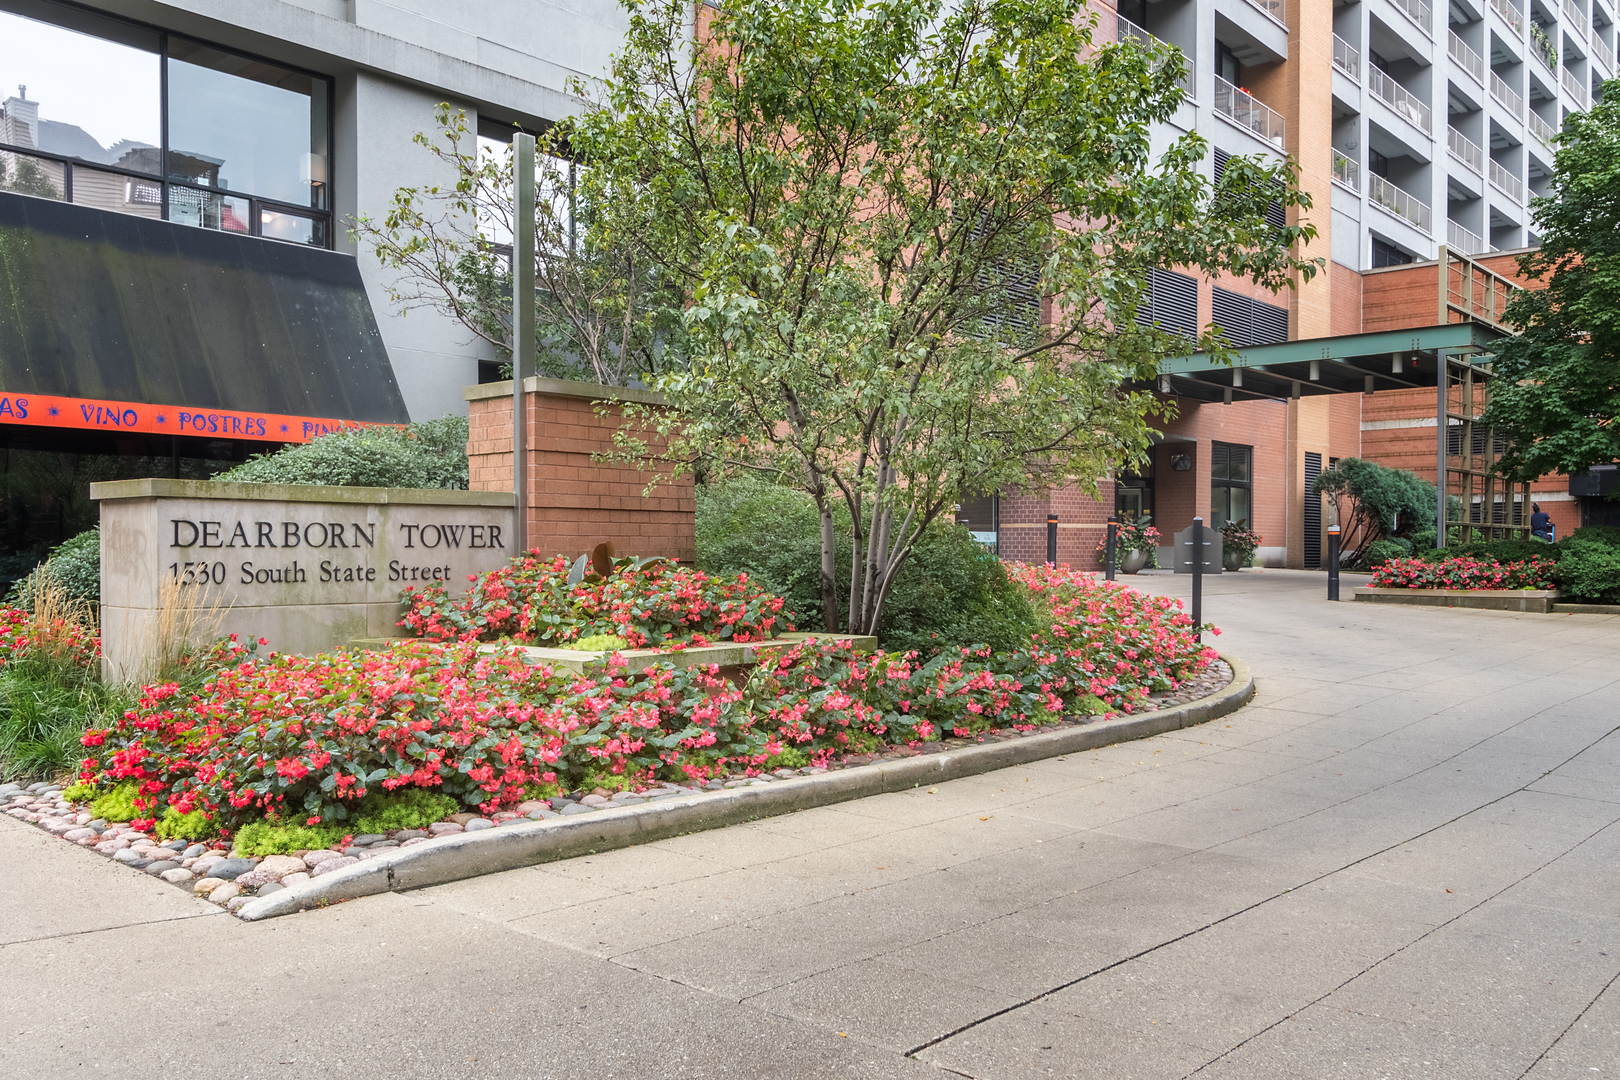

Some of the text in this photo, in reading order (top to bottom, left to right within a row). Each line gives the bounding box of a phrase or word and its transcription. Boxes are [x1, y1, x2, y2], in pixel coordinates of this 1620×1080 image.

[80, 403, 138, 427] VINO
[179, 412, 266, 436] POSTRES
[170, 519, 505, 548] DEARBORN TOWER
[169, 560, 451, 585] 1530 South State Street
